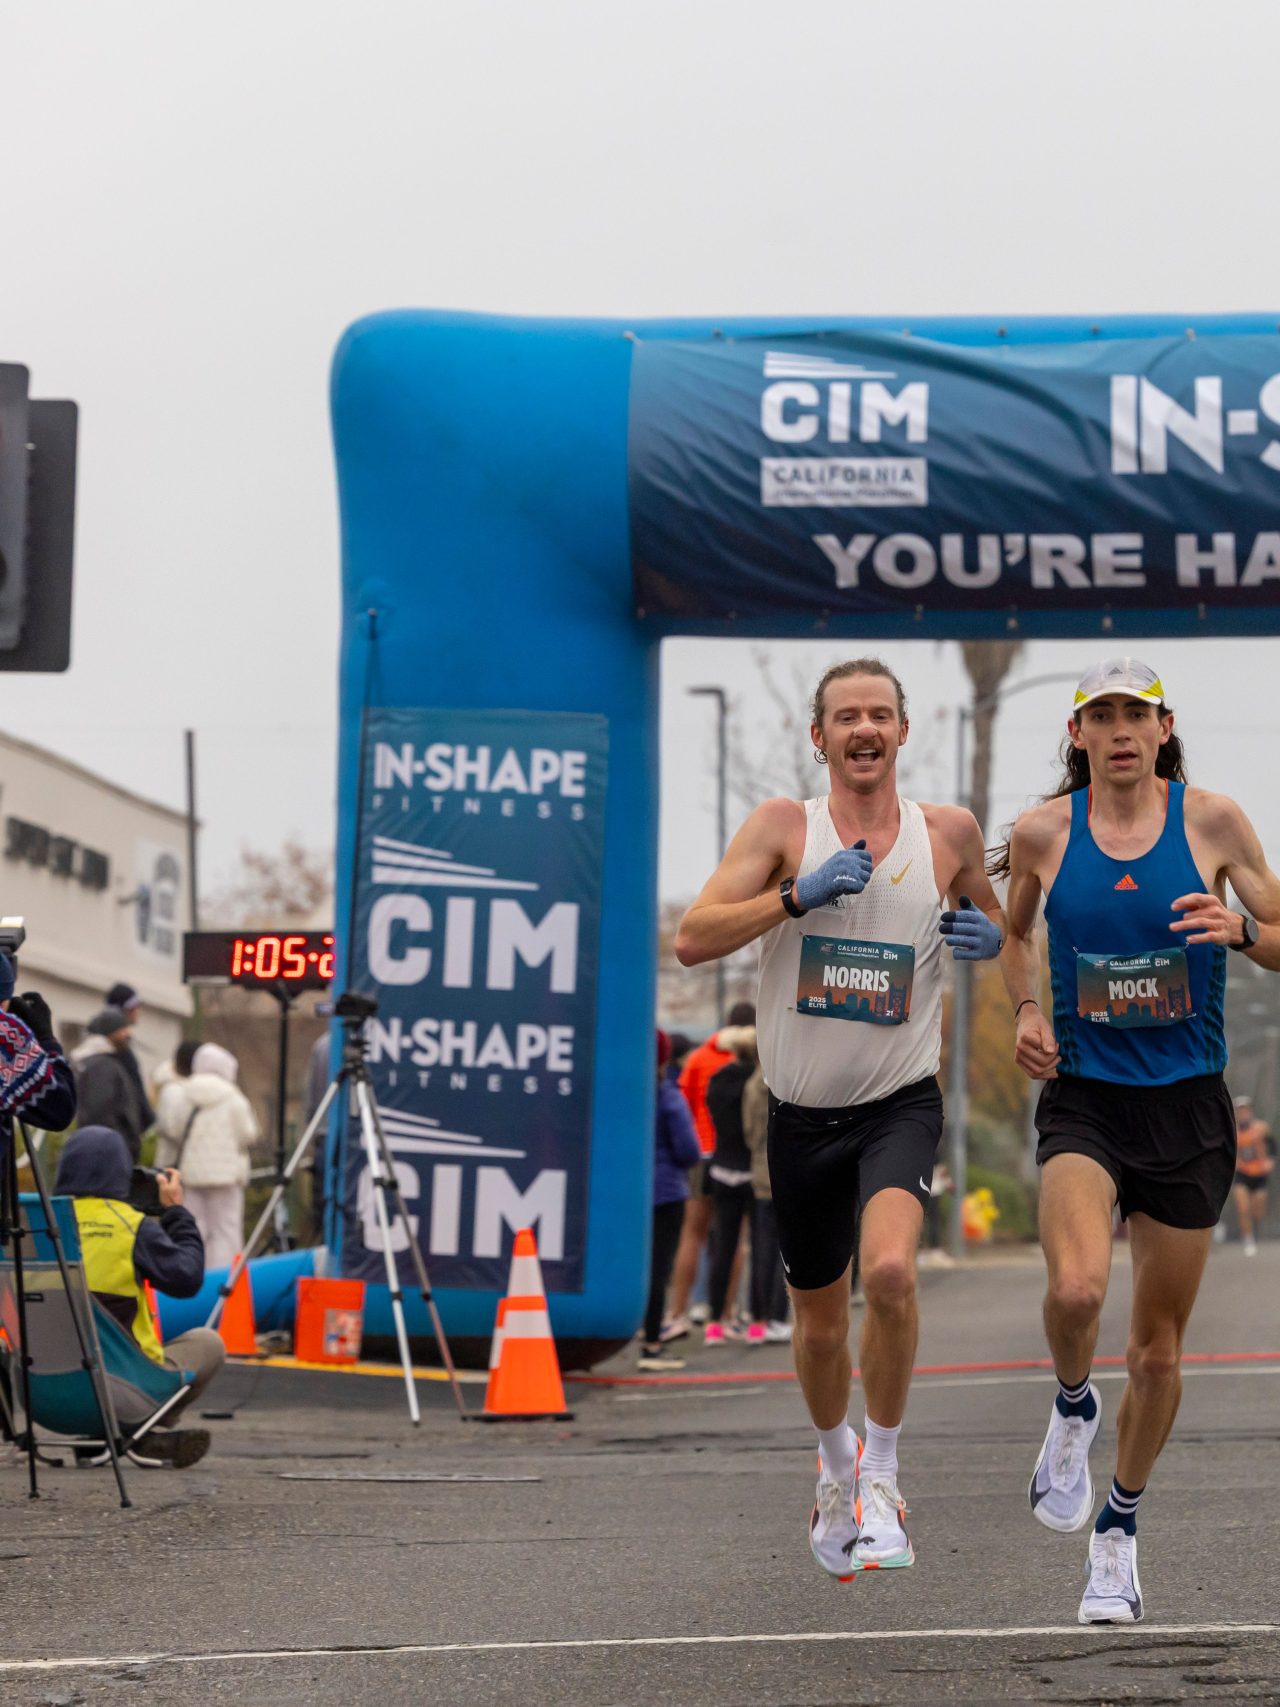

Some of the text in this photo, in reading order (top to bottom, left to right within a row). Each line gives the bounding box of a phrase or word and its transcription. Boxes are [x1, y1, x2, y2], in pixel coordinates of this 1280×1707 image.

[761, 381, 929, 443] CIM
[773, 465, 914, 484] CALIFORNIA
[812, 532, 1146, 589] YOU'RE
[373, 742, 587, 797] IN-SHAPE
[373, 794, 584, 821] FITNESS
[367, 893, 580, 993] CIM
[837, 944, 880, 955] CALIFORNIA
[823, 965, 889, 992] NORRIS
[1108, 978, 1159, 1001] MOCK
[388, 1069, 572, 1096] ITNESS
[356, 1160, 568, 1261] CIM
